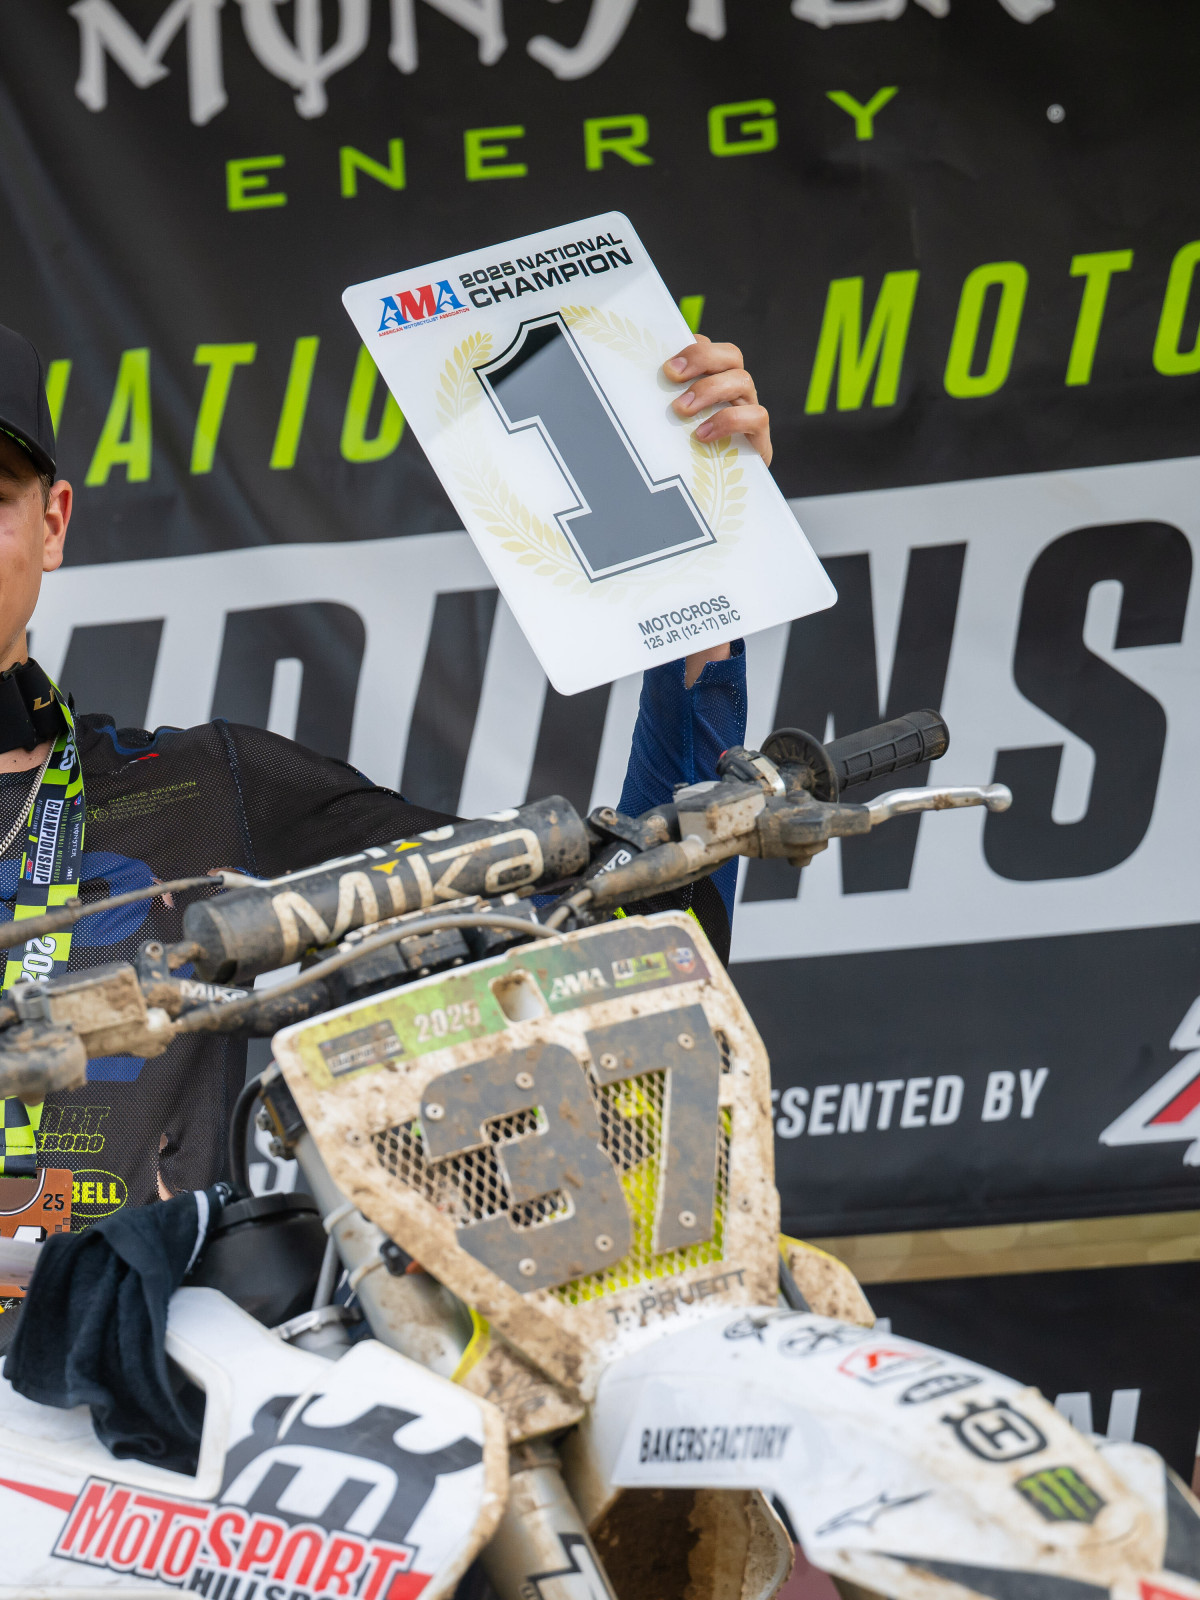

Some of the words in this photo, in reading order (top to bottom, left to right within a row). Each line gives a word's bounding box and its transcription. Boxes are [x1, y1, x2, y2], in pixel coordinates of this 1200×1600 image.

[225, 86, 899, 211] ENERGY
[458, 260, 517, 290] 2025
[515, 232, 623, 273] NATIONAL
[467, 246, 634, 309] CHAMPION
[377, 279, 469, 333] AMA
[378, 326, 404, 338] AMERICAN
[472, 311, 717, 584] 1
[637, 595, 731, 636] MOTOCROSS
[643, 634, 665, 651] 125
[665, 629, 682, 644] JR
[681, 616, 720, 641] (12-17)
[717, 609, 741, 626] B/C
[35, 800, 63, 884] CHAMPIONSHIP
[549, 966, 609, 1001] AMA
[413, 1000, 482, 1044] 2025
[980, 1066, 1050, 1123] BY
[419, 1003, 721, 1293] 37
[42, 1193, 65, 1212] 25
[71, 1181, 122, 1204] BELL
[638, 1425, 793, 1464] BAKERSFACTORY
